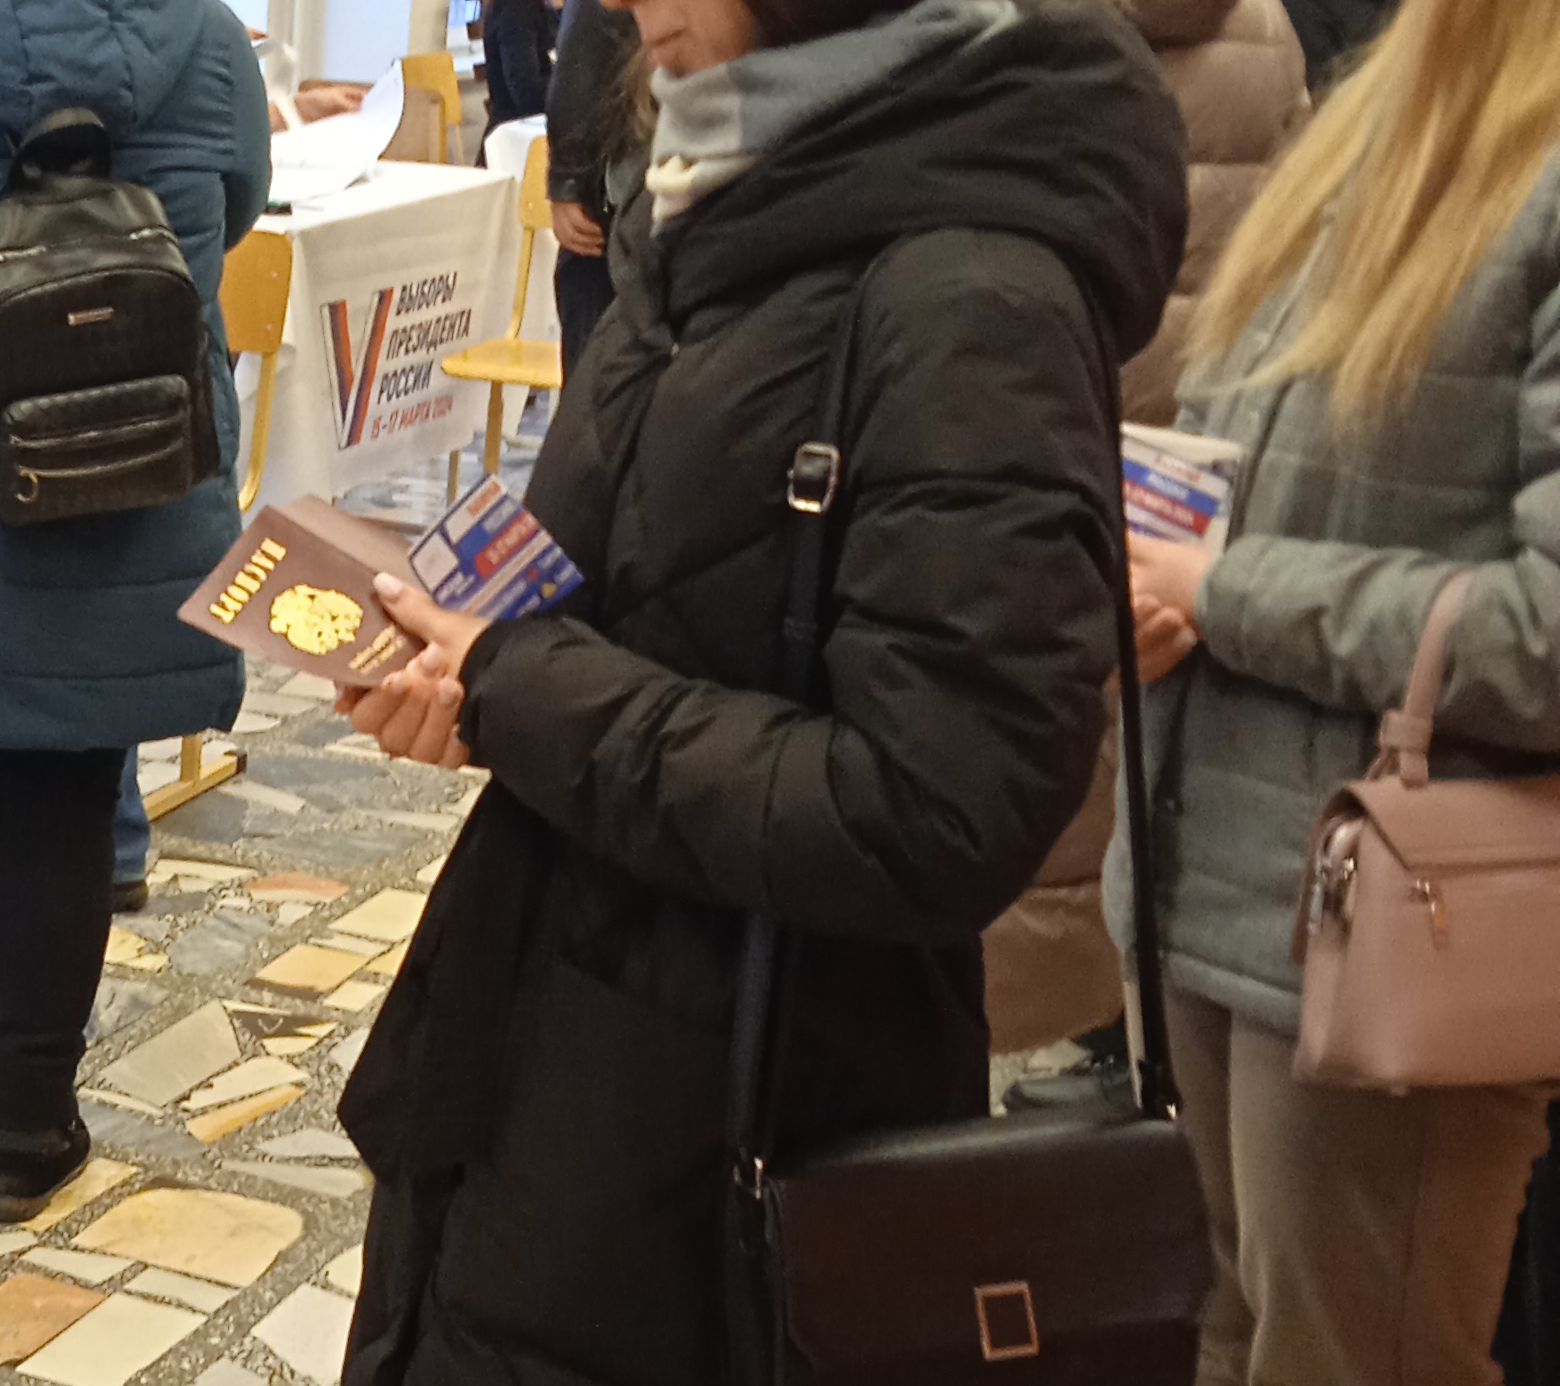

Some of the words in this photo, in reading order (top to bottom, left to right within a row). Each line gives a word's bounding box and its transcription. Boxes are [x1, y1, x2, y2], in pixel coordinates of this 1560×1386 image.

[395, 271, 457, 316] ВЫБОРЫ
[386, 308, 472, 360] ПРЕЗИДЕНТА
[378, 359, 434, 405] РОССИИ
